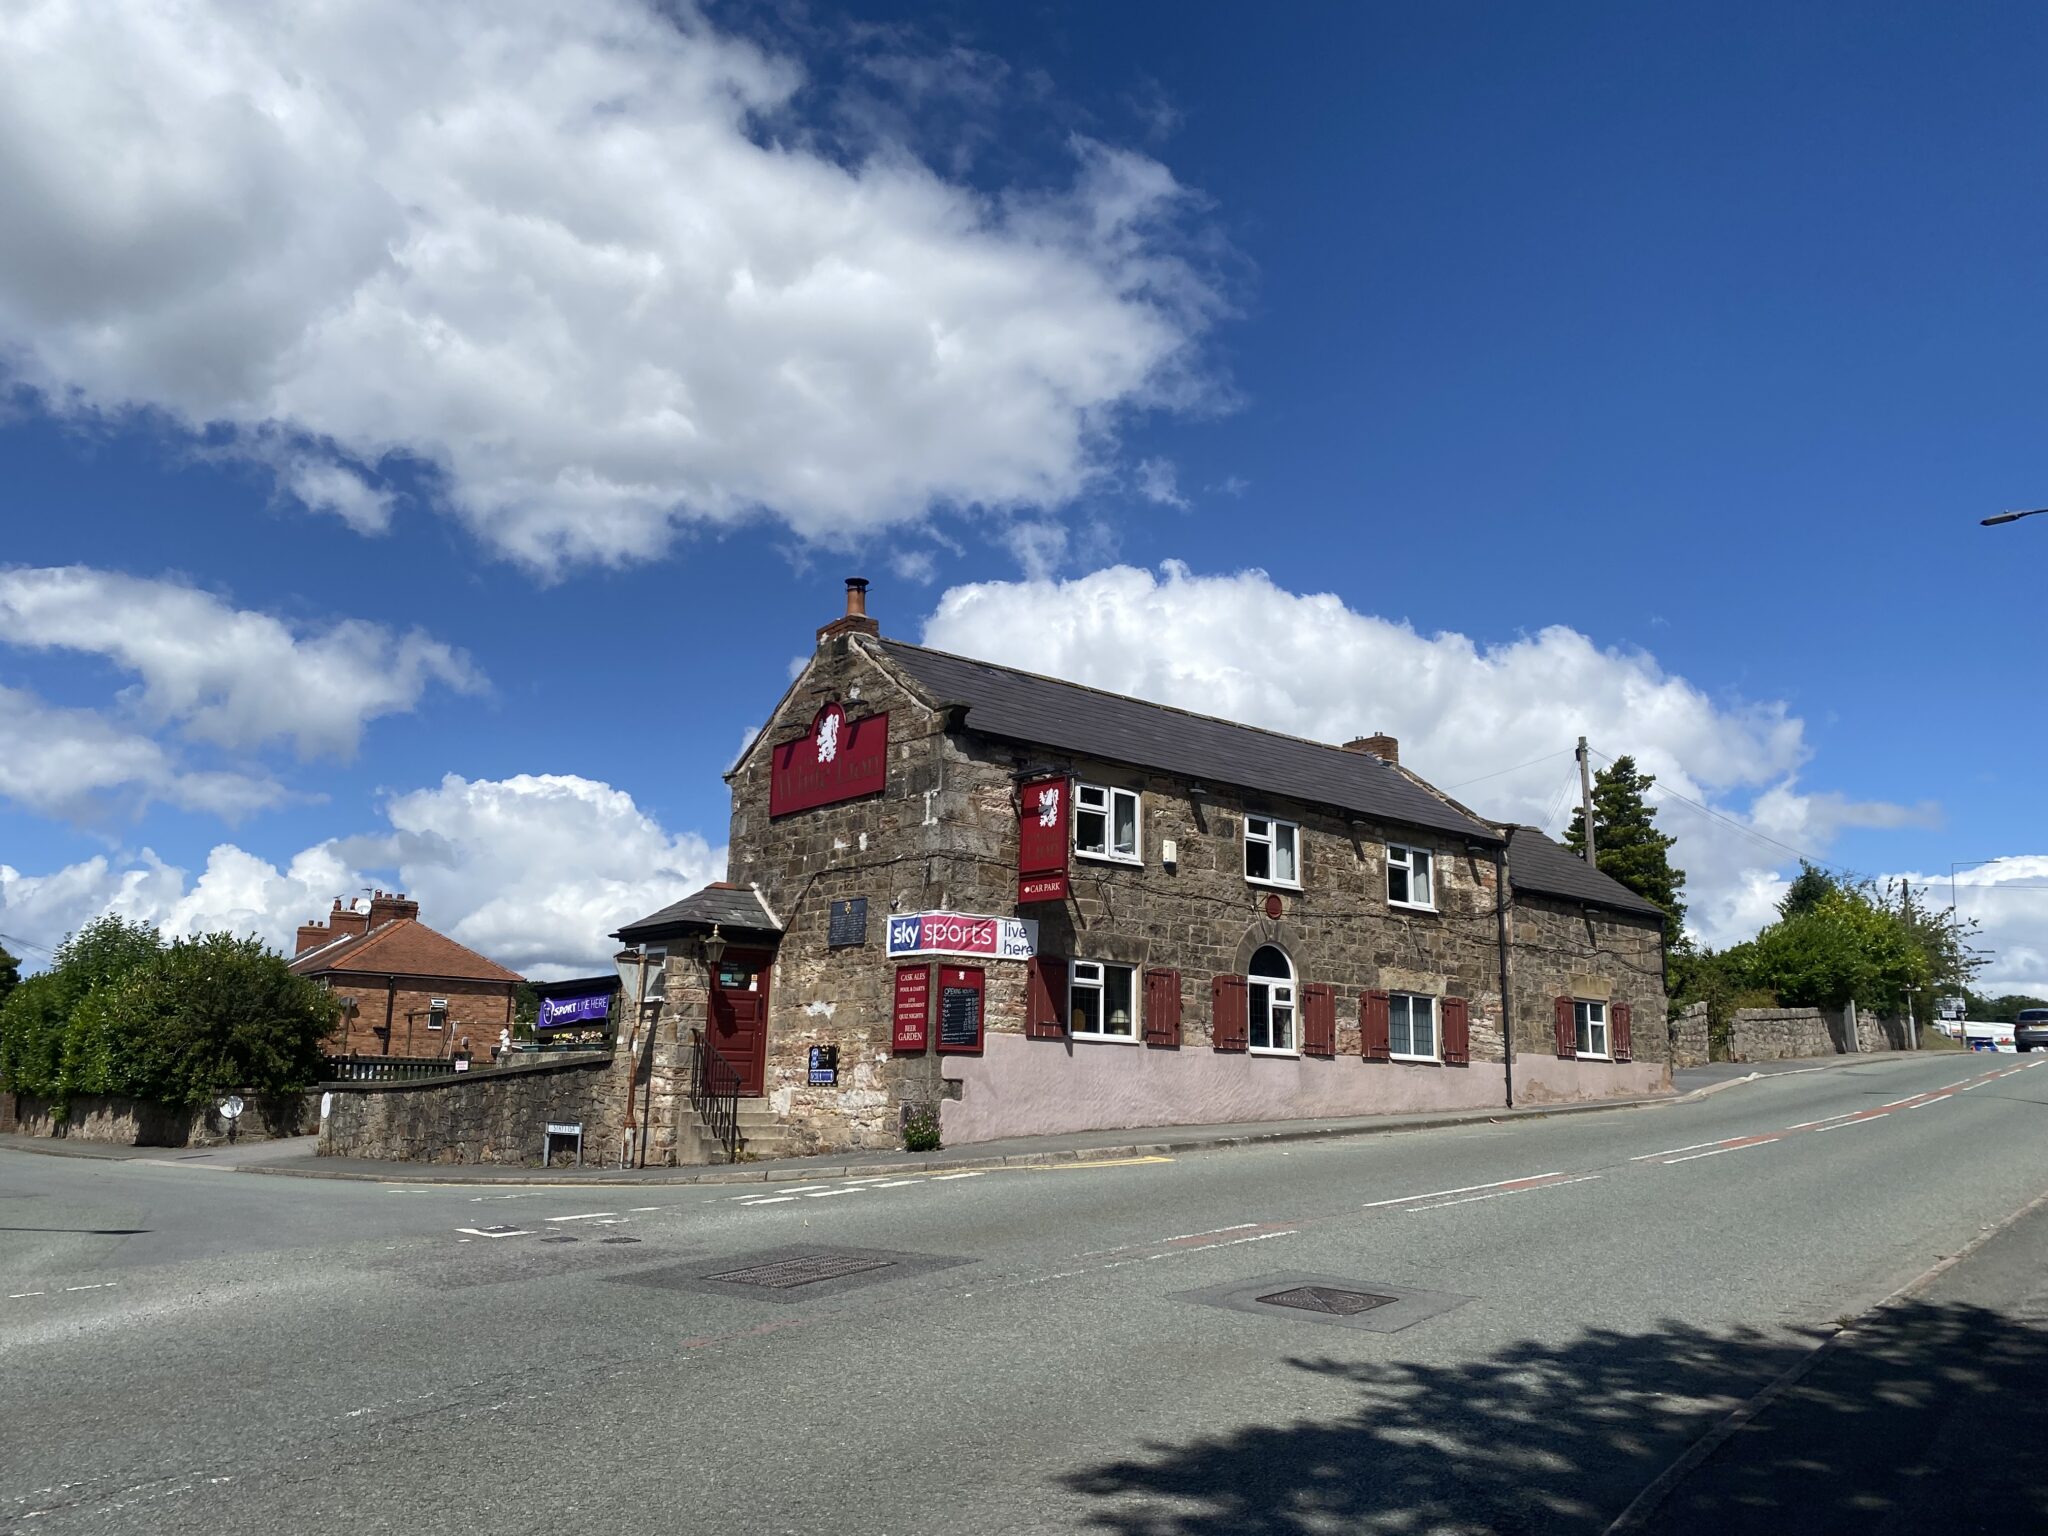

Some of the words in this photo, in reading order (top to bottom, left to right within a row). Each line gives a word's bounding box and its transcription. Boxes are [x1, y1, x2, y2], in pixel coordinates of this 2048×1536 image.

[778, 764, 831, 800] White
[835, 752, 880, 785] Lion
[1030, 884, 1043, 893] CAR
[1044, 882, 1060, 892] PARK
[893, 921, 919, 948] sky
[924, 923, 992, 945] sports
[1004, 923, 1027, 938] live
[1004, 941, 1034, 956] here
[900, 973, 913, 981] CASK
[914, 972, 926, 980] ALES
[553, 1002, 576, 1016] SPORT
[590, 997, 607, 1009] HERE
[898, 1013, 909, 1021] QUIZ
[904, 1024, 916, 1032] BEER
[898, 1032, 923, 1041] GARDEN
